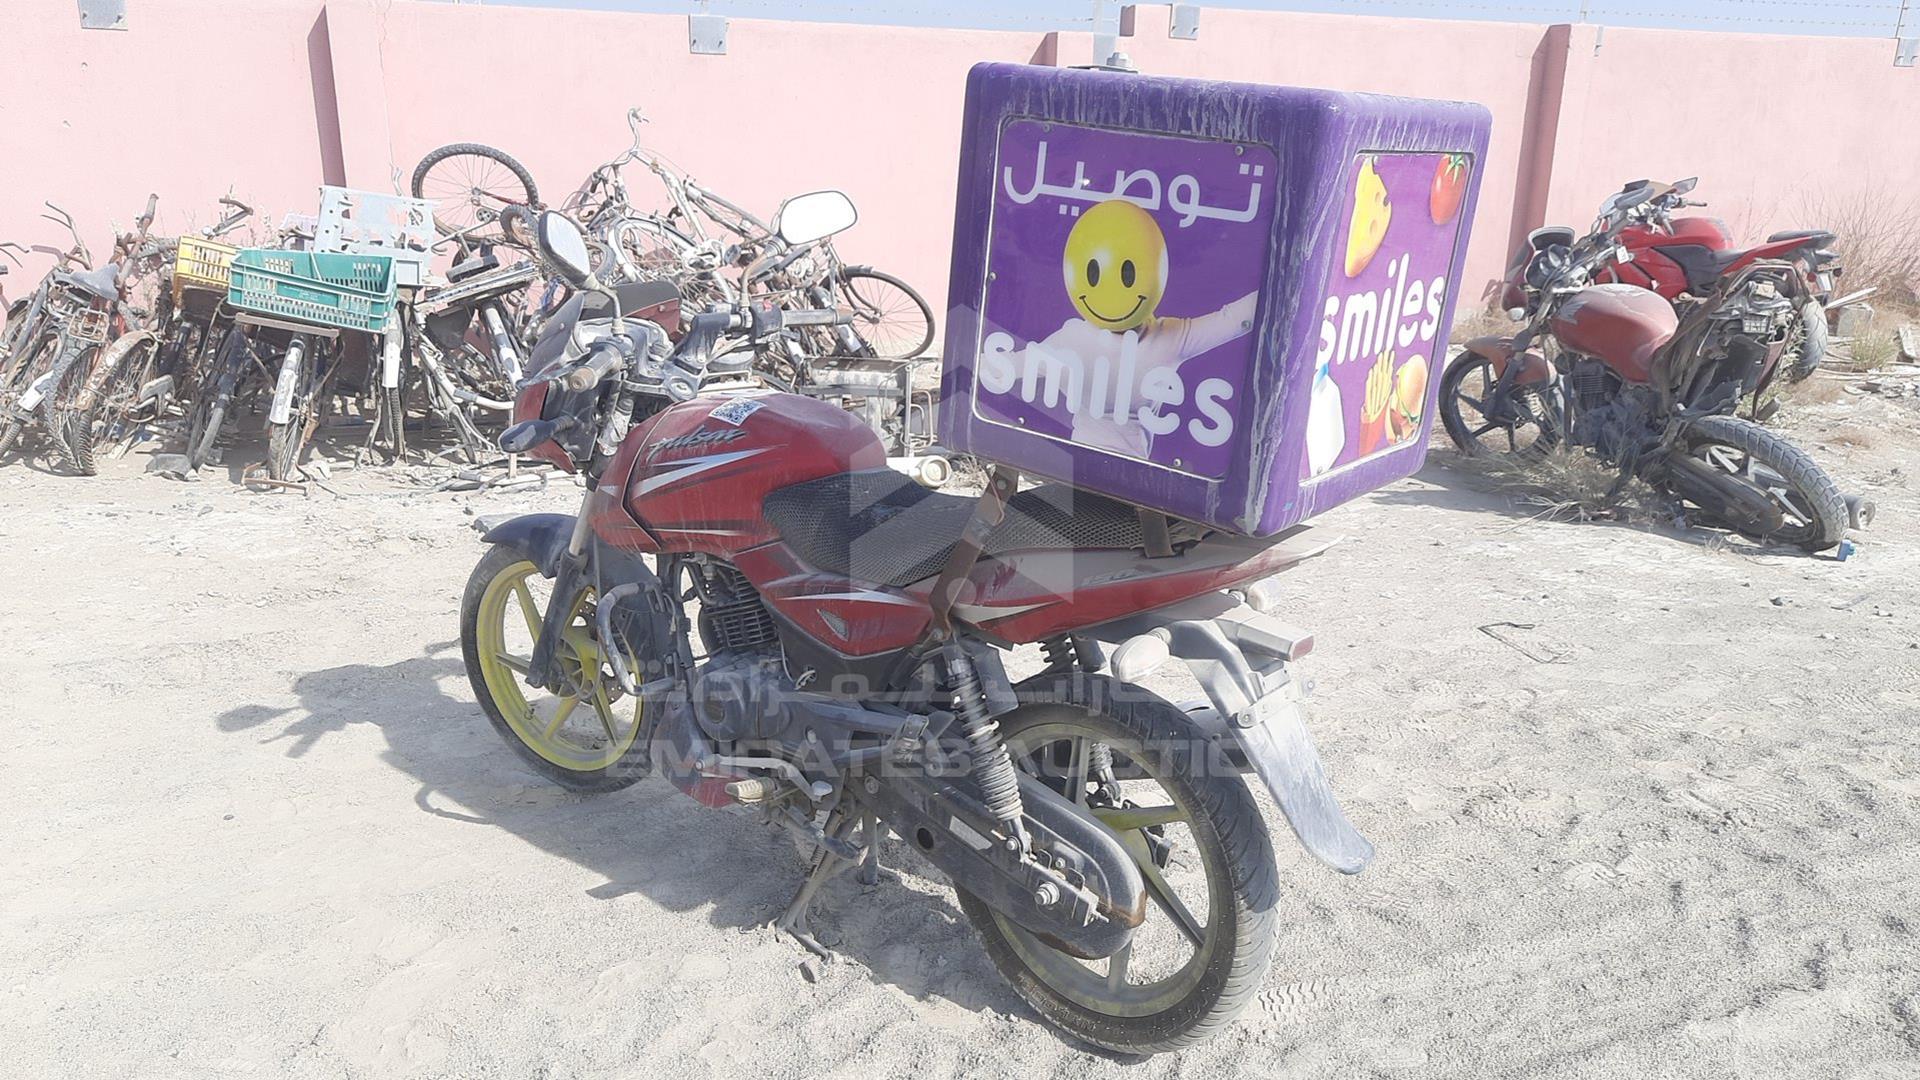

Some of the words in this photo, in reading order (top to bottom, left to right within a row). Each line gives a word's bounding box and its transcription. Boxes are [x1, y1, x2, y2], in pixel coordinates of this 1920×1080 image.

[1003, 141, 1264, 227] توصيل
[1316, 253, 1445, 368] smiles
[979, 331, 1234, 447] smiles
